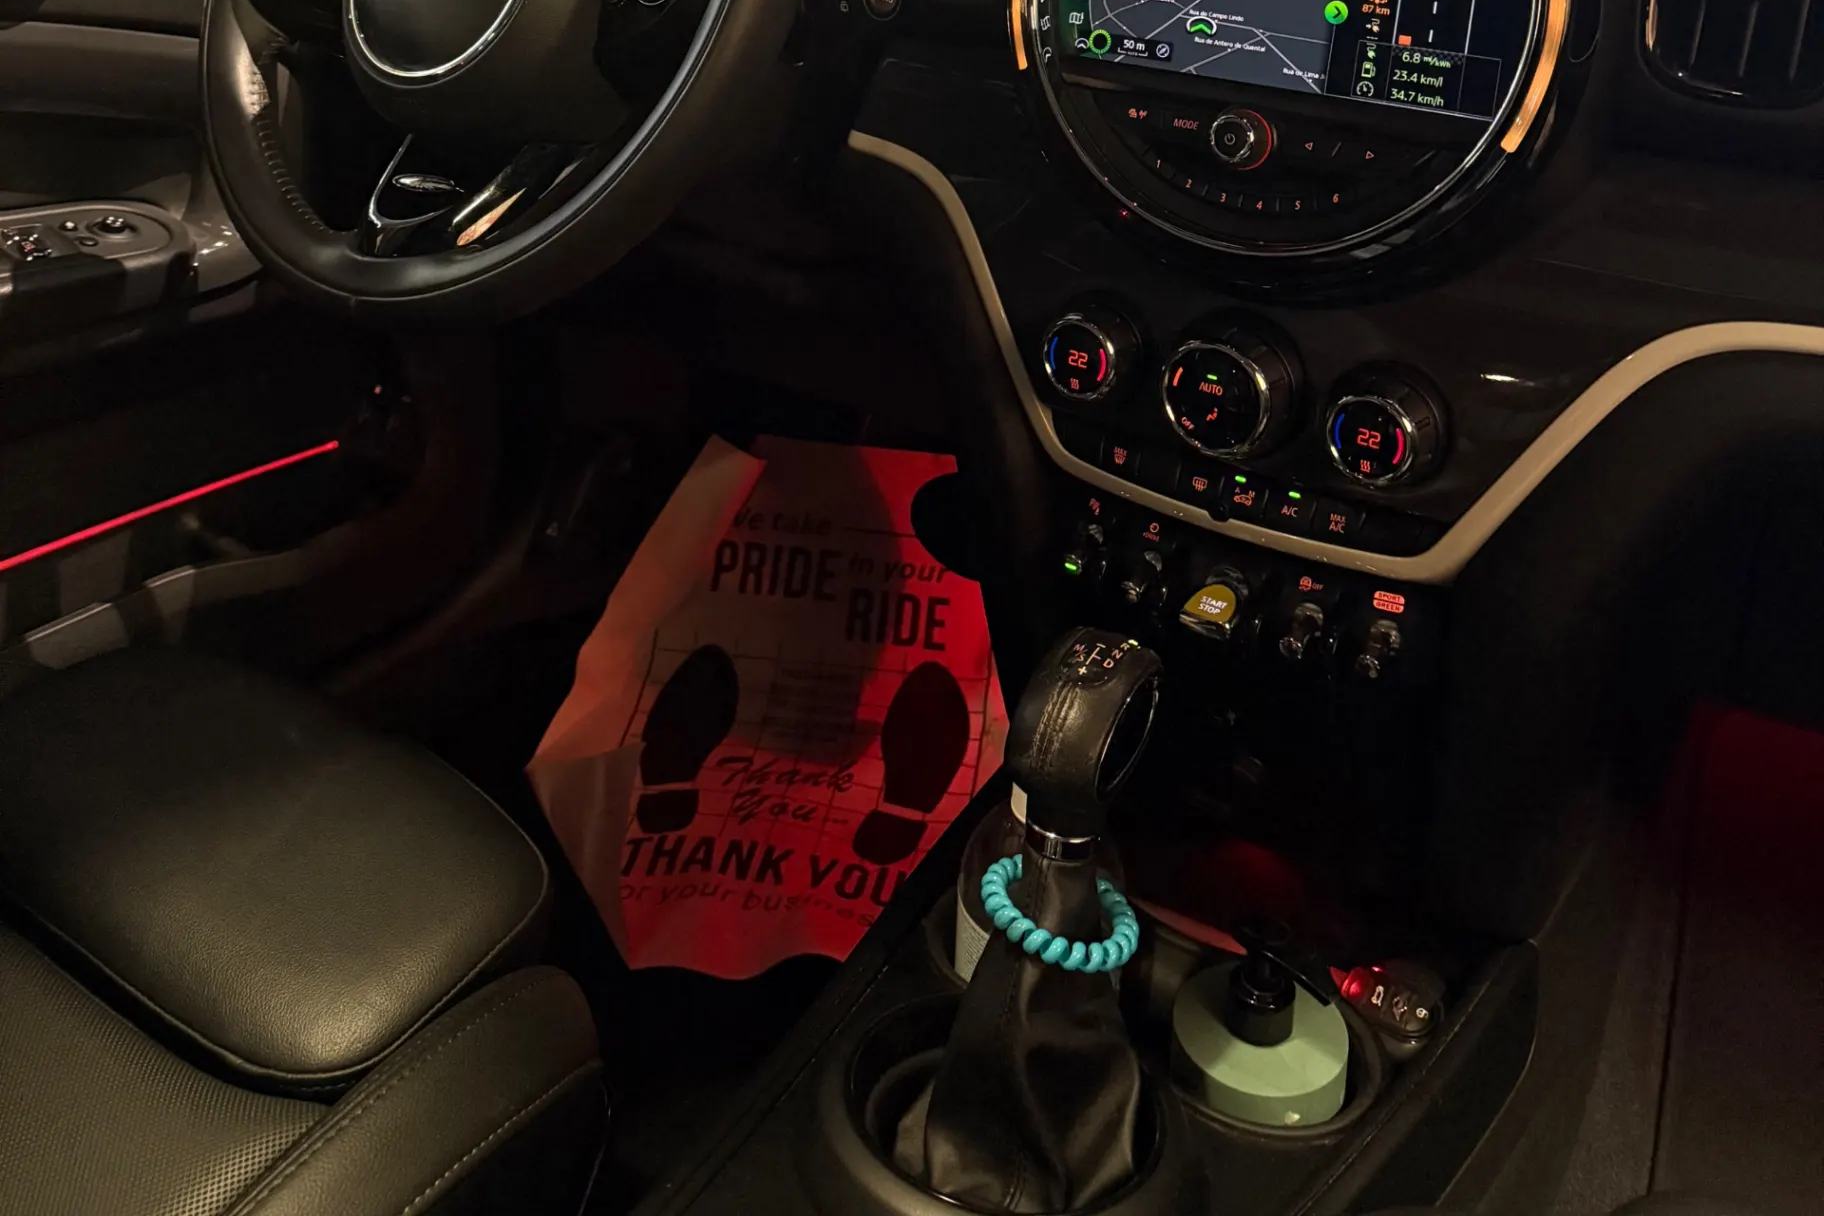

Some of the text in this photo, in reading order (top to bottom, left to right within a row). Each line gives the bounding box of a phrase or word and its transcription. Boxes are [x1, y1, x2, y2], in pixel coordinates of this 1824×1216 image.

[1208, 11, 1228, 20] Campo
[1361, 4, 1390, 15] 87 km
[1123, 39, 1135, 49] 50
[1194, 36, 1204, 44] Rua
[1402, 51, 1421, 64] 6.8
[1283, 67, 1294, 75] Rua
[1392, 69, 1444, 87] 23.4 km/l
[1390, 88, 1444, 107] 34.7 km/h
[1173, 118, 1200, 130] MODE
[1156, 159, 1339, 211] 1 2 3 4 5 6
[1067, 349, 1089, 370] 22
[1199, 382, 1223, 396] AUTO
[1181, 416, 1195, 431] OFF
[1356, 427, 1382, 450] 22
[1281, 505, 1298, 518] A/C
[1330, 513, 1346, 523] MAX
[1329, 522, 1346, 534] A/C
[711, 540, 948, 601] PRIDE in your
[1201, 596, 1228, 609] START
[1378, 592, 1401, 602] SPORT
[1198, 603, 1221, 615] STOP
[1376, 601, 1400, 612] GREEN
[846, 588, 950, 652] RIDE
[1111, 649, 1123, 659] N
[1103, 658, 1115, 669] D
[717, 756, 854, 792] Thank
[622, 835, 907, 907] THANK YOU
[621, 885, 650, 902] or
[656, 884, 733, 905] your
